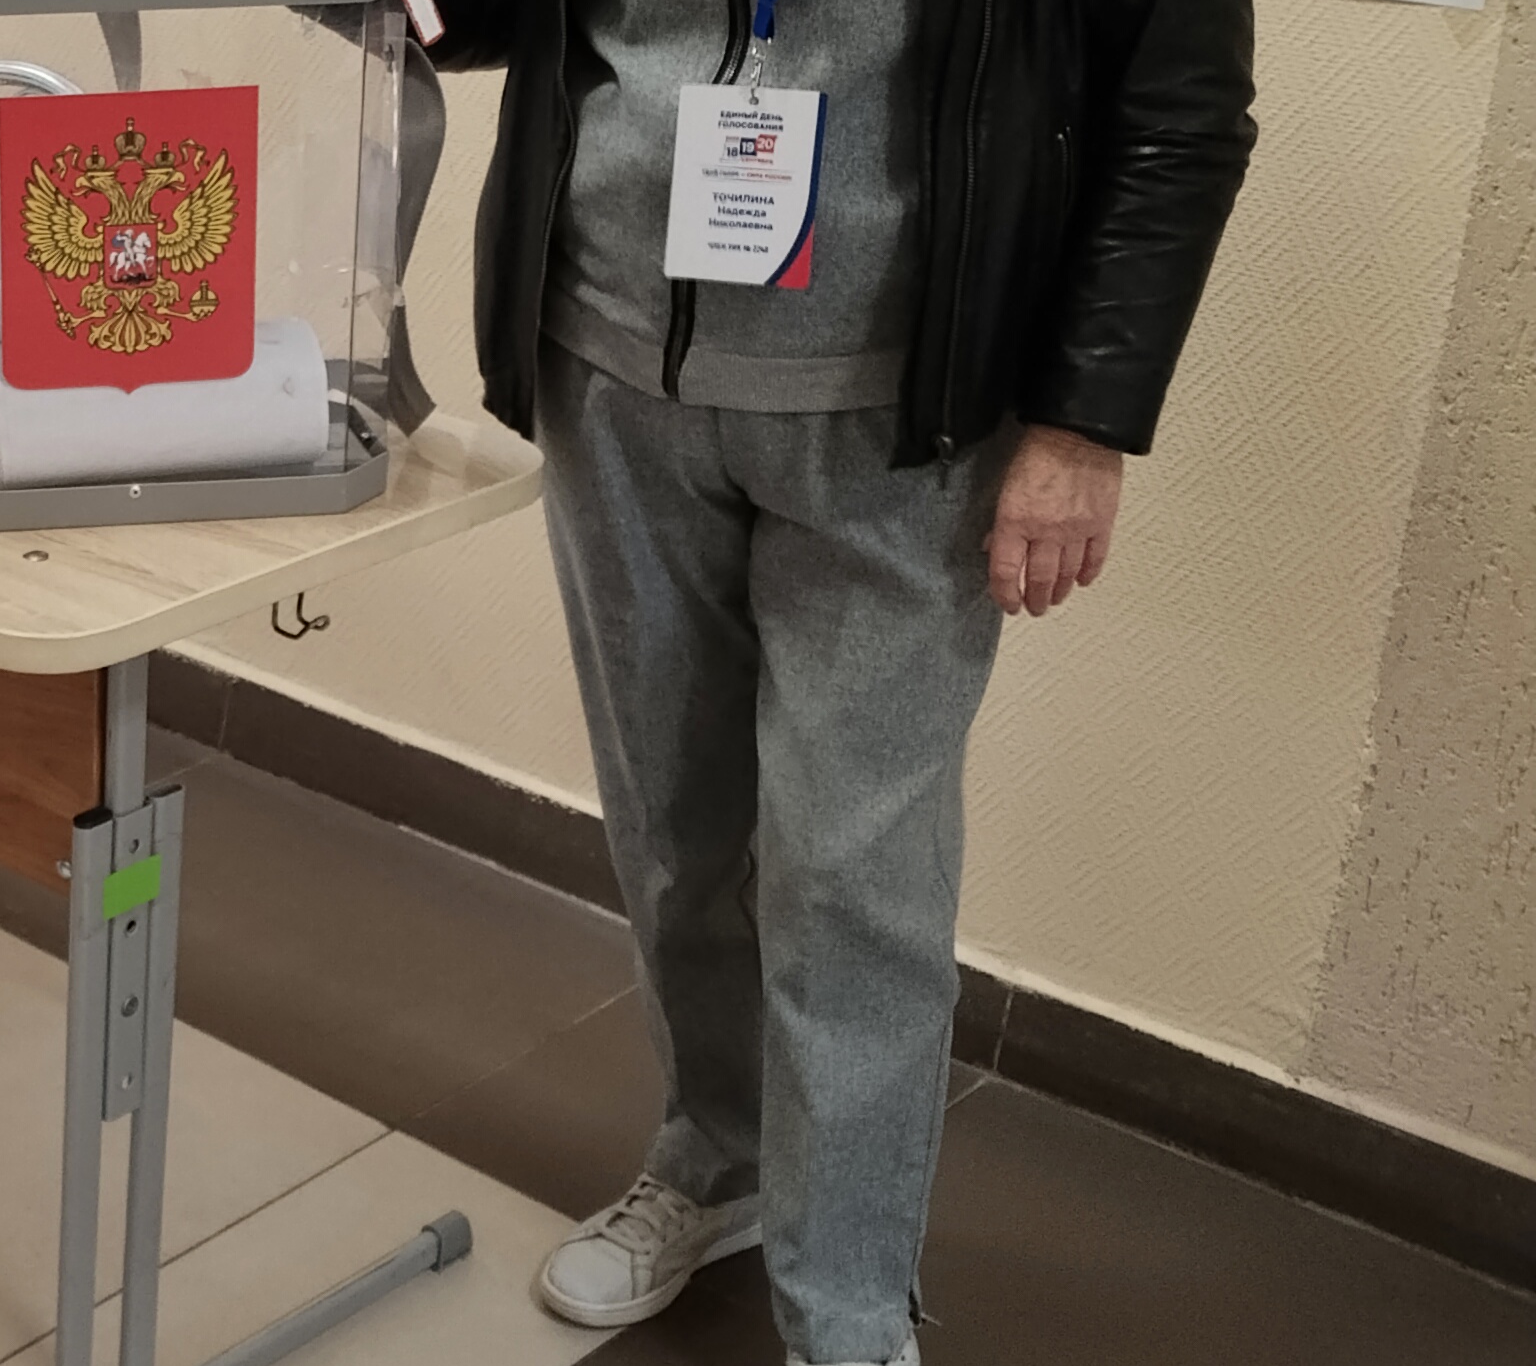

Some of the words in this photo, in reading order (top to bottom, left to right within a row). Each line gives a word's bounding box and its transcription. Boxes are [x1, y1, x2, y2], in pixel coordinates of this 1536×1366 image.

[757, 137, 774, 150] 20
[712, 192, 774, 205] ТОЧИЛИНА
[717, 206, 767, 218] Надежда
[708, 217, 773, 231] Николаевна
